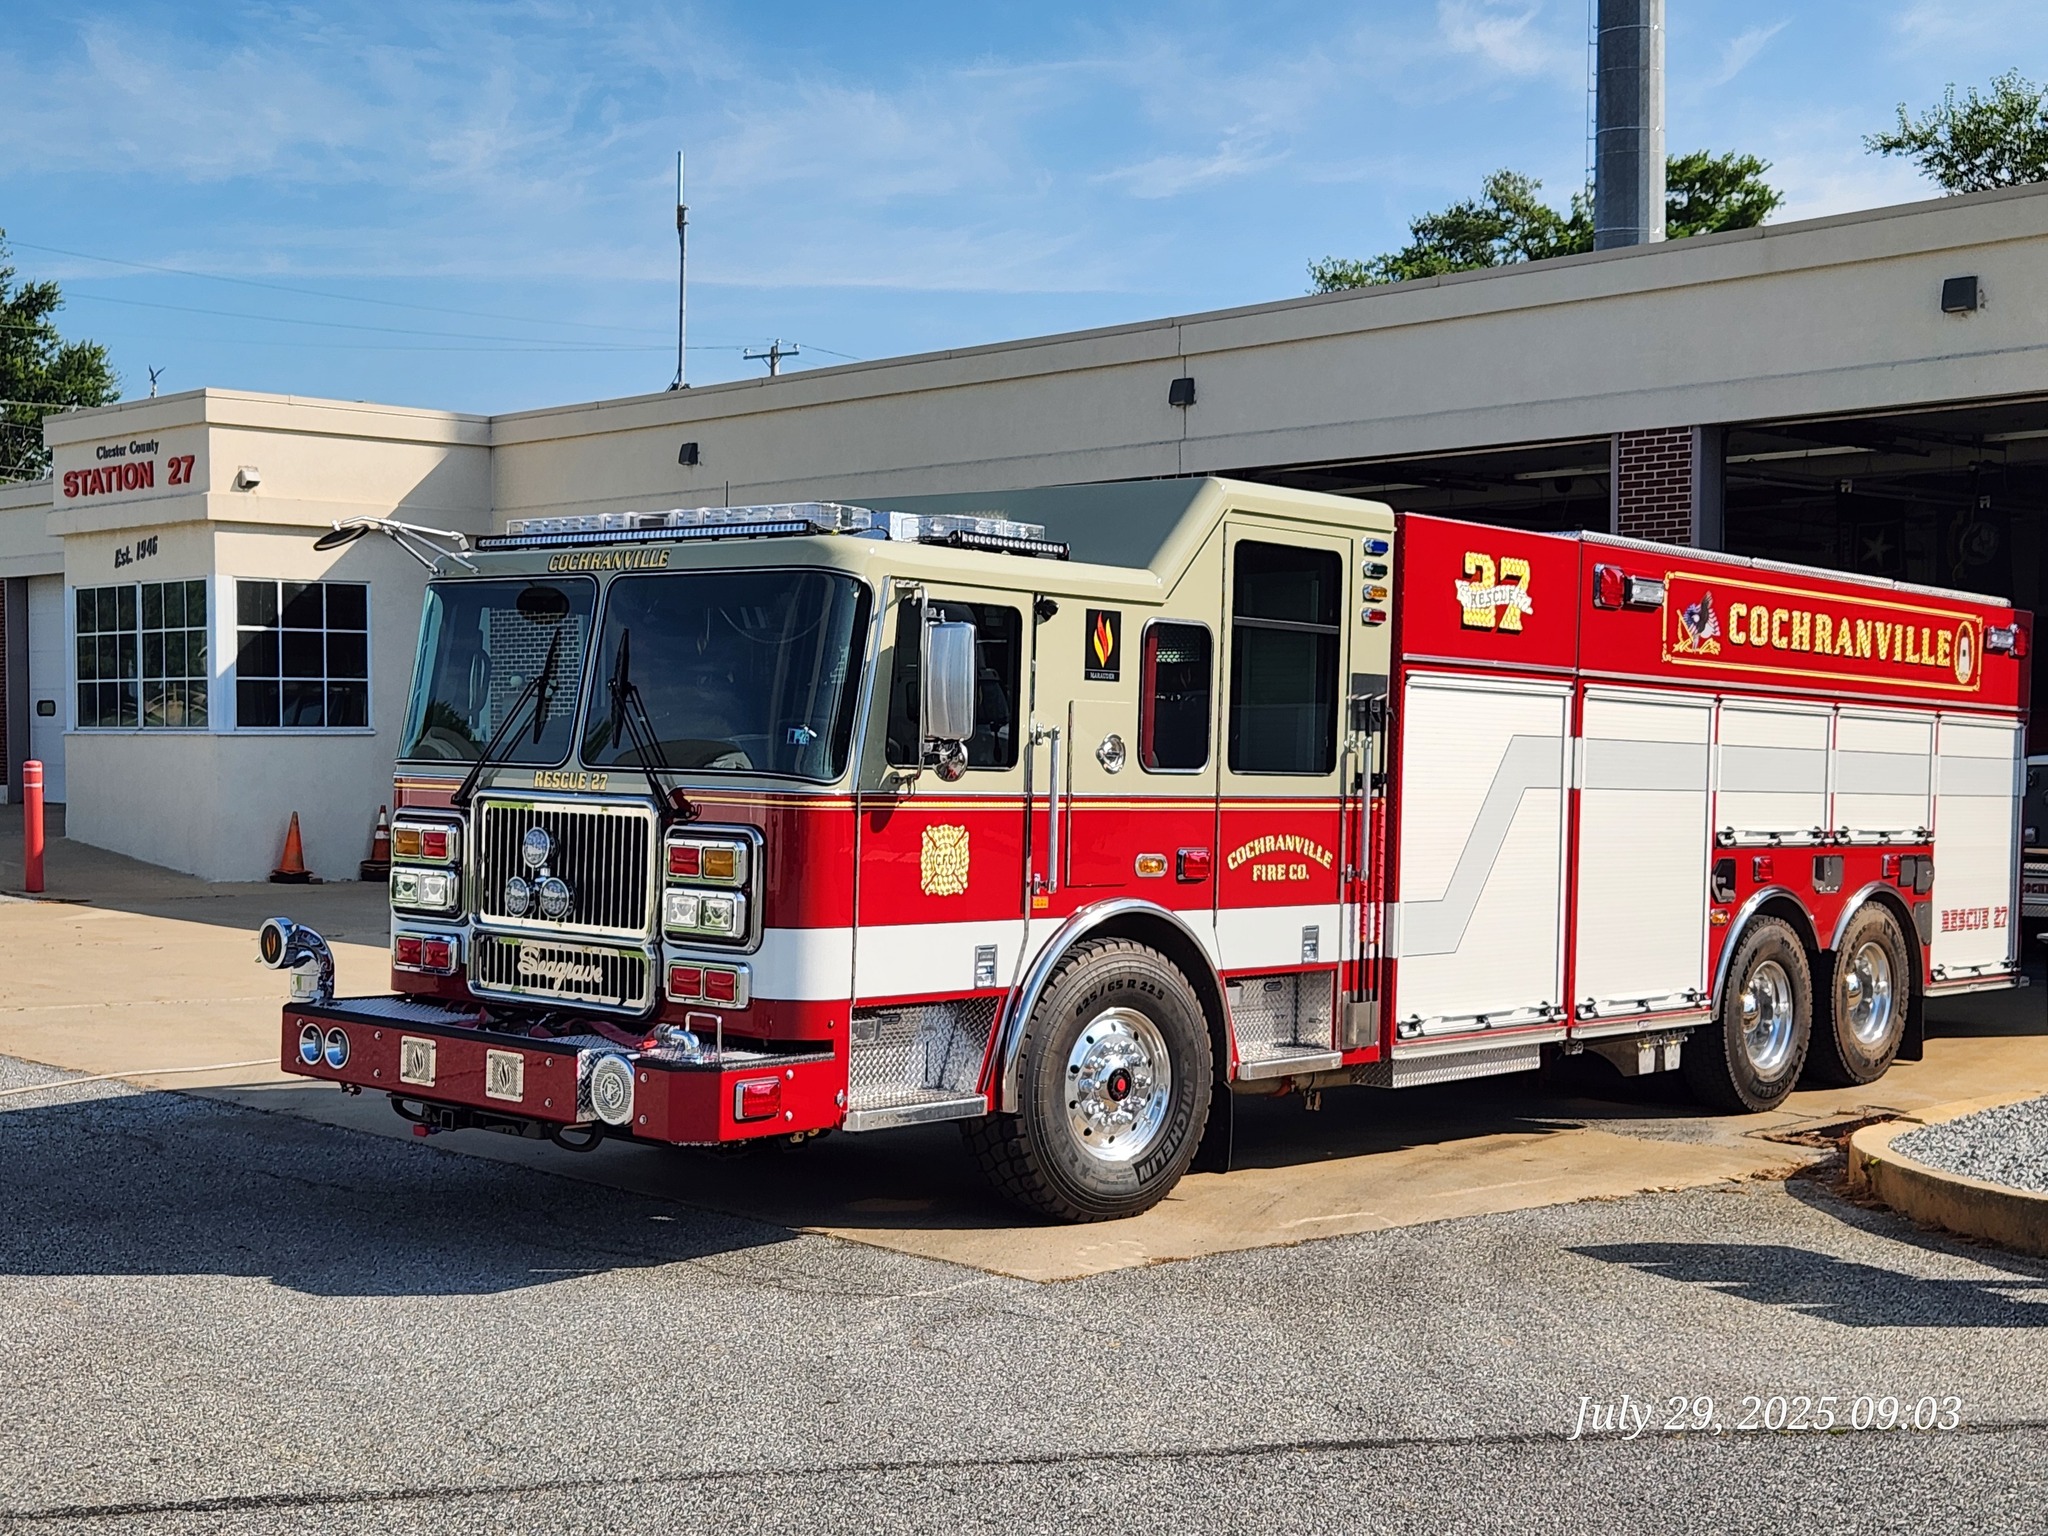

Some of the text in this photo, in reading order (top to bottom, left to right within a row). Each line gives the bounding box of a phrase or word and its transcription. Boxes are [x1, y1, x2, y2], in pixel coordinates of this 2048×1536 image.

[96, 439, 159, 460] Chester County
[63, 455, 196, 498] STATION 27
[114, 535, 158, 569] Est. 1946
[548, 549, 671, 572] COCHRANVILLE
[1462, 551, 1531, 633] 27
[1470, 589, 1515, 606] RESCUE
[1728, 602, 1952, 668] COCHRANVILLE
[533, 770, 609, 791] RESCUE 27
[1227, 834, 1333, 870] COCHRANVILLE
[1252, 863, 1310, 882] FIRE CO.
[1941, 906, 2008, 932] RESCUE 27
[517, 946, 604, 991] Seagrave
[1126, 979, 1137, 989] R
[1139, 981, 1165, 1001] 22.5
[1138, 1079, 1194, 1183] MICHELIN
